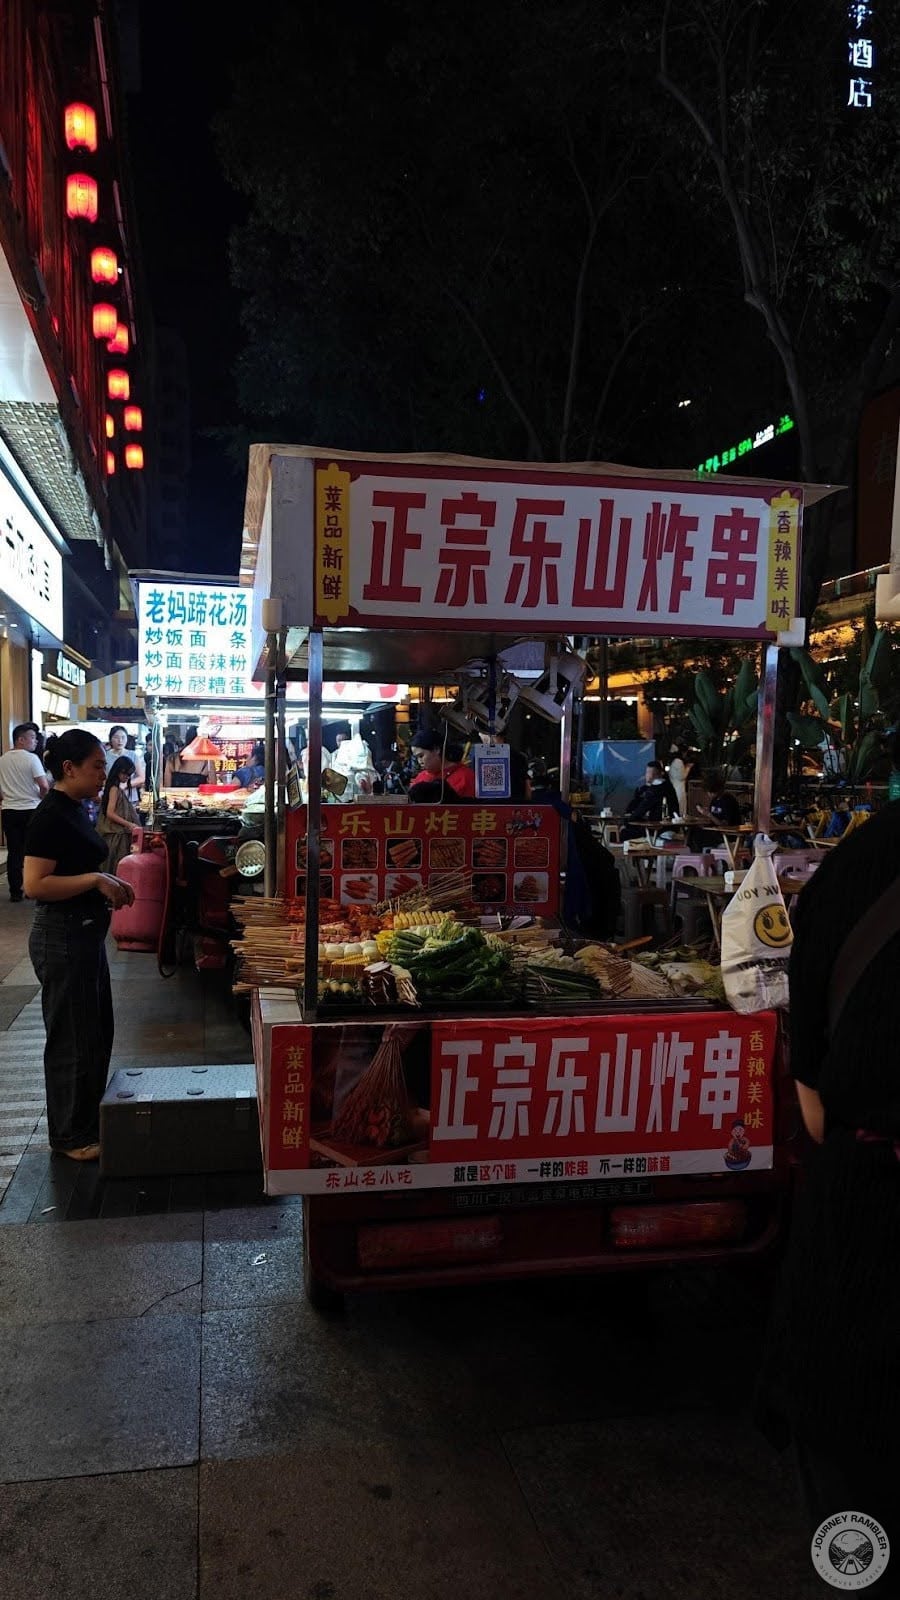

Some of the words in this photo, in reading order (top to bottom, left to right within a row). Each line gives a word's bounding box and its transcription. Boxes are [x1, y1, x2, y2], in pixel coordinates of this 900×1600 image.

[322, 485, 344, 601] 菜品新鲜
[362, 490, 761, 615] 正宗乐山炸串
[771, 510, 791, 619] 香辣美味
[145, 589, 247, 626] 老妈蹄花汤
[339, 809, 497, 837] 乐山炸串
[282, 1045, 305, 1150] 菜品新鲜
[432, 1030, 743, 1140] 正宗乐山炸串
[744, 1030, 765, 1129] 香辣美味
[326, 1168, 413, 1189] 乐山名小吃
[453, 1163, 517, 1183] 就是这个味
[527, 1160, 589, 1178] 一样的炸串
[599, 1156, 671, 1175] 不一样的味道
